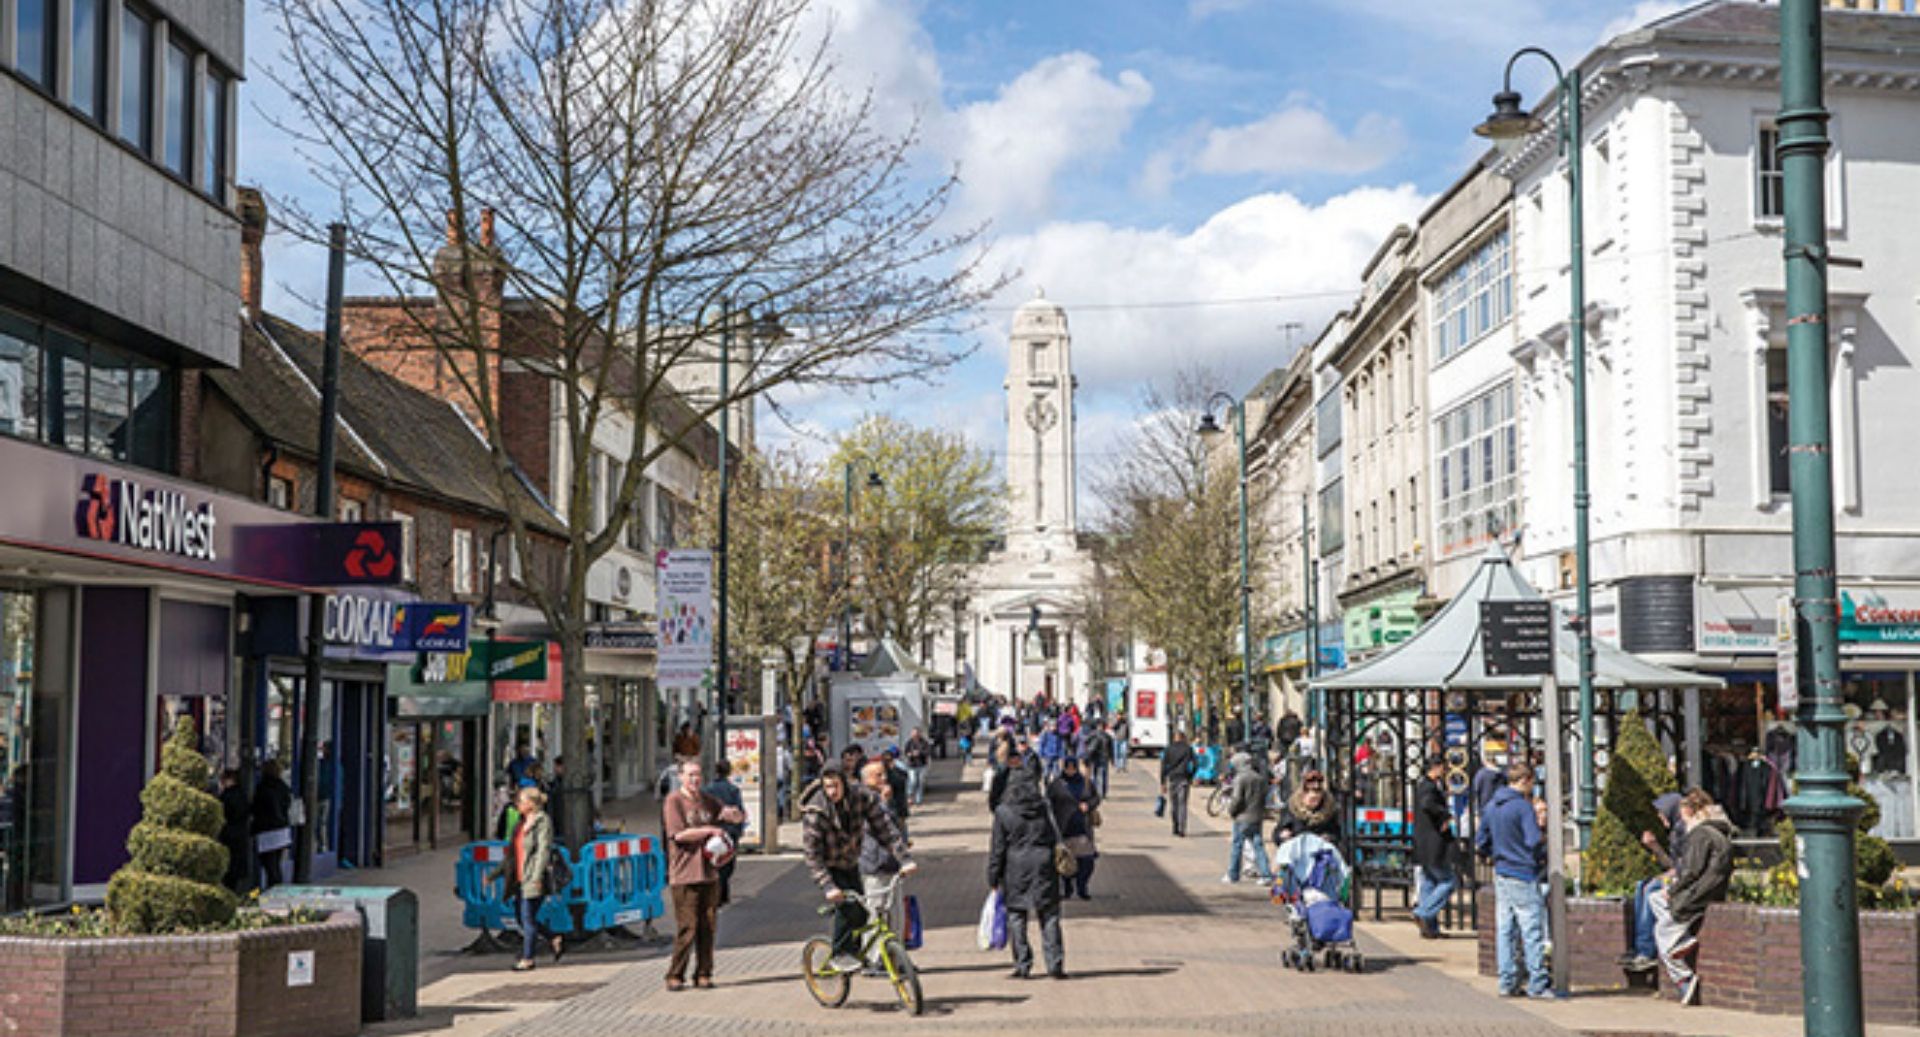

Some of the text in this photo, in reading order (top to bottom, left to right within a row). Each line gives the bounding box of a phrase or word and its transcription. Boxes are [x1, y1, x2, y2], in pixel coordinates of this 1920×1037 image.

[119, 479, 216, 561] NatWest
[323, 593, 394, 647] CORAL
[416, 637, 462, 650] CORAL
